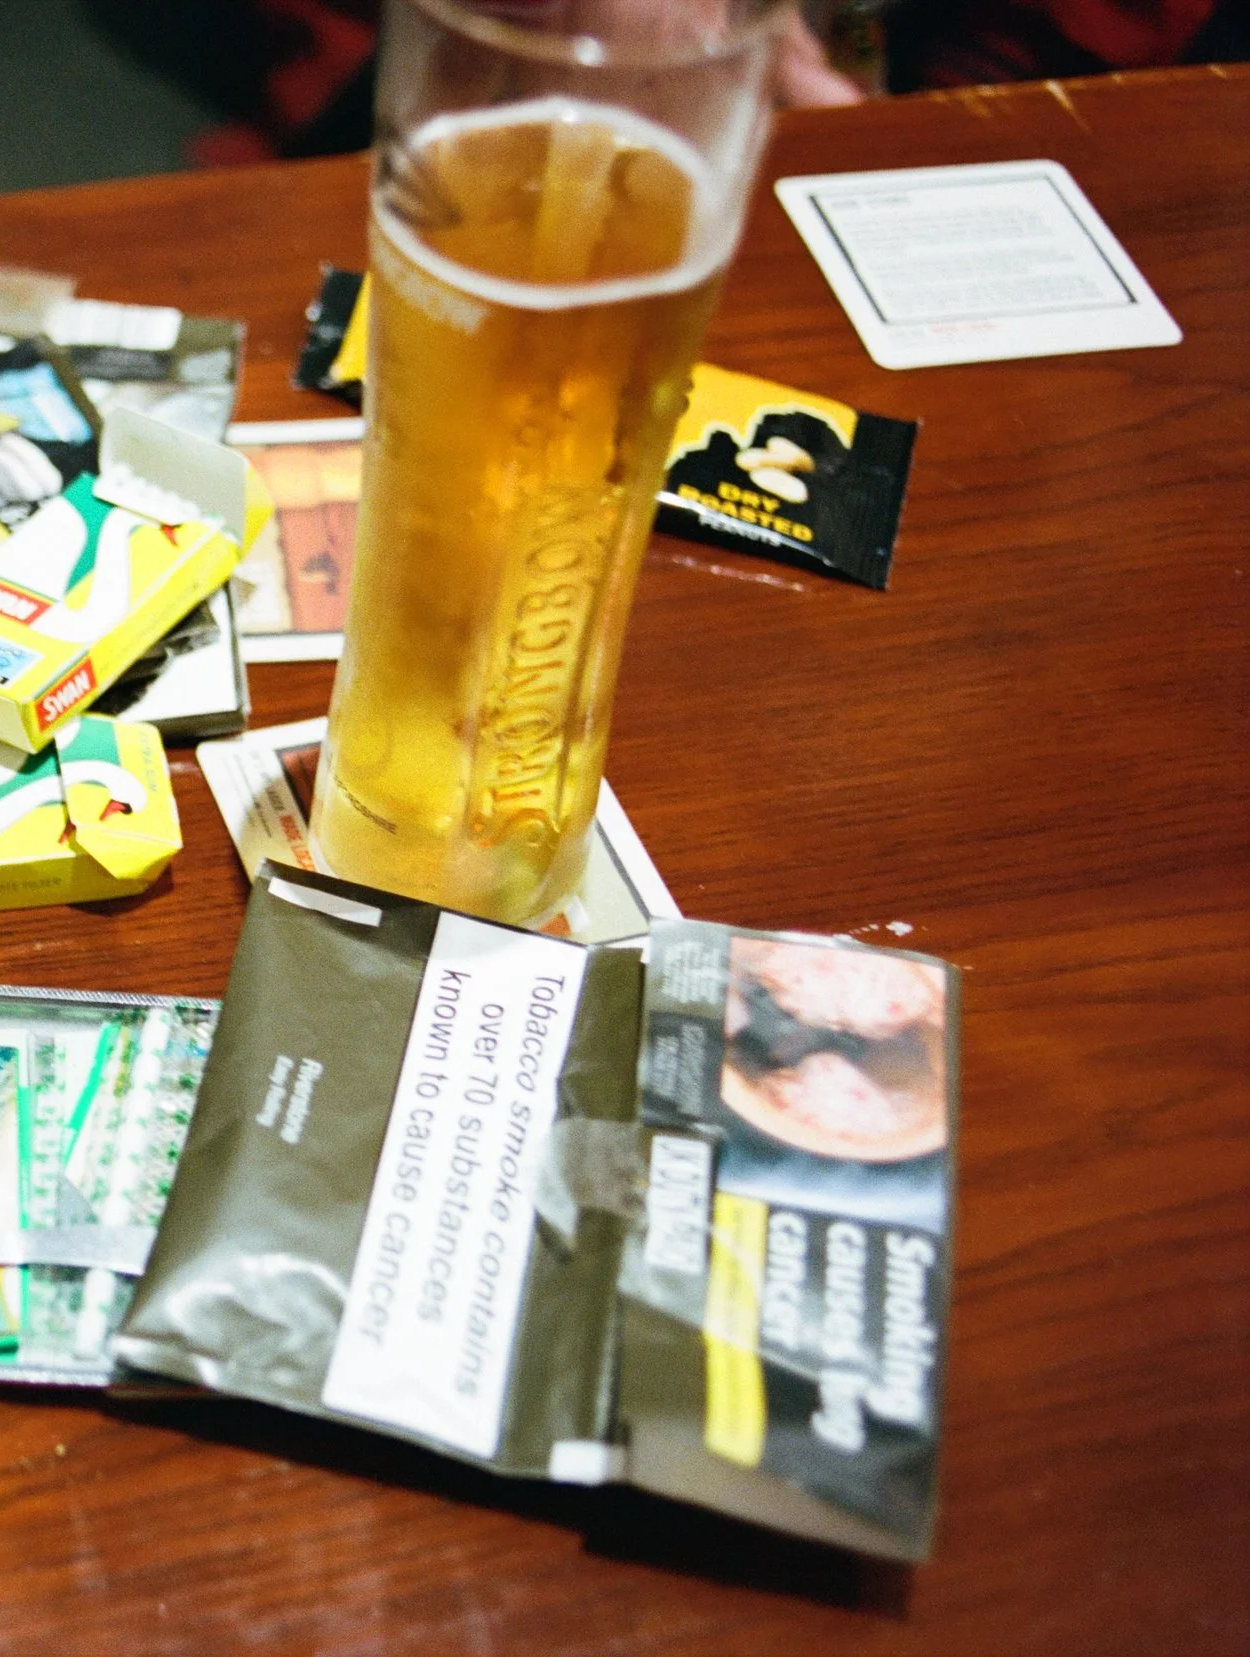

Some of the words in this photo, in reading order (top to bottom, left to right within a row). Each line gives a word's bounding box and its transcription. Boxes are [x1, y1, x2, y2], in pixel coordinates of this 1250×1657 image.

[678, 483, 814, 542] ROASTED
[718, 481, 781, 513] DRY
[43, 670, 91, 722] SWAN
[424, 968, 472, 1061] known
[473, 1003, 505, 1065] over
[513, 975, 566, 1093] Tobacco
[415, 1071, 449, 1100] to
[463, 1074, 499, 1106] 70
[391, 1107, 435, 1203] cause
[490, 1100, 533, 1223] smoke
[417, 1114, 482, 1323] substances
[358, 1212, 412, 1345] cancer
[455, 1231, 506, 1396] contains
[761, 1211, 807, 1350] cancer
[821, 1222, 867, 1359] causes
[863, 1231, 937, 1425] Smoking
